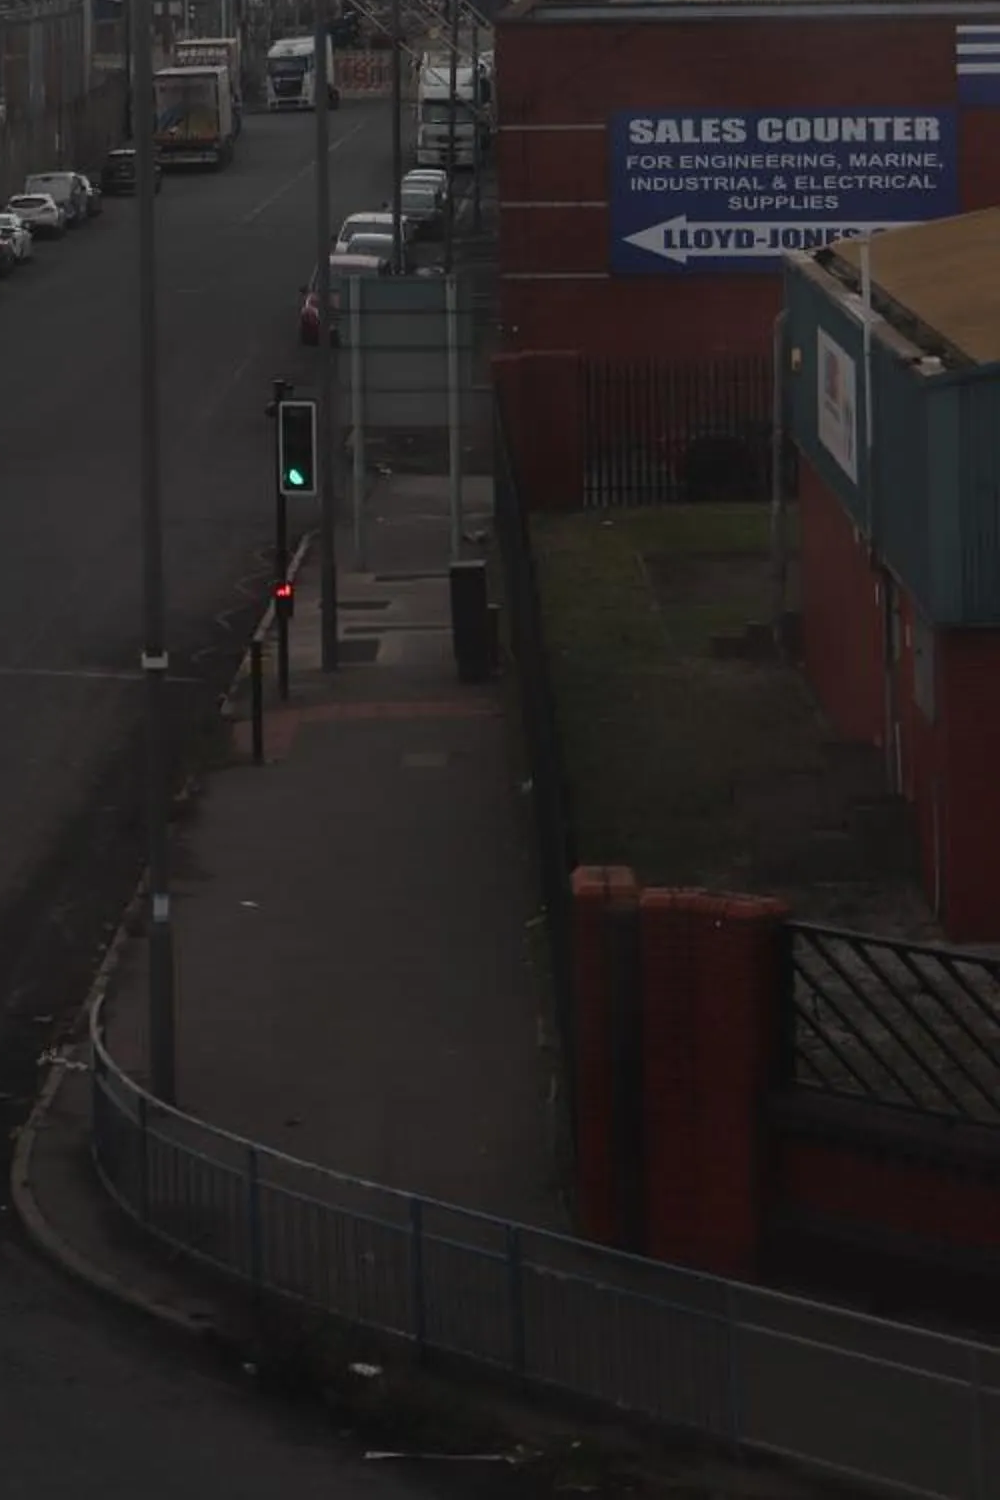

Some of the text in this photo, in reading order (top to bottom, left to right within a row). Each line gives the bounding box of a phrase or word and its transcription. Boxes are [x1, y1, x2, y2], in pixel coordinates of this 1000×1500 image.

[629, 116, 941, 144] SALES COUNTER
[626, 152, 944, 170] FOR ENGINEERING, MARINE,
[631, 175, 937, 192] INDUSTRIAL & ELECTRICAL
[728, 195, 839, 211] SUPPLIES
